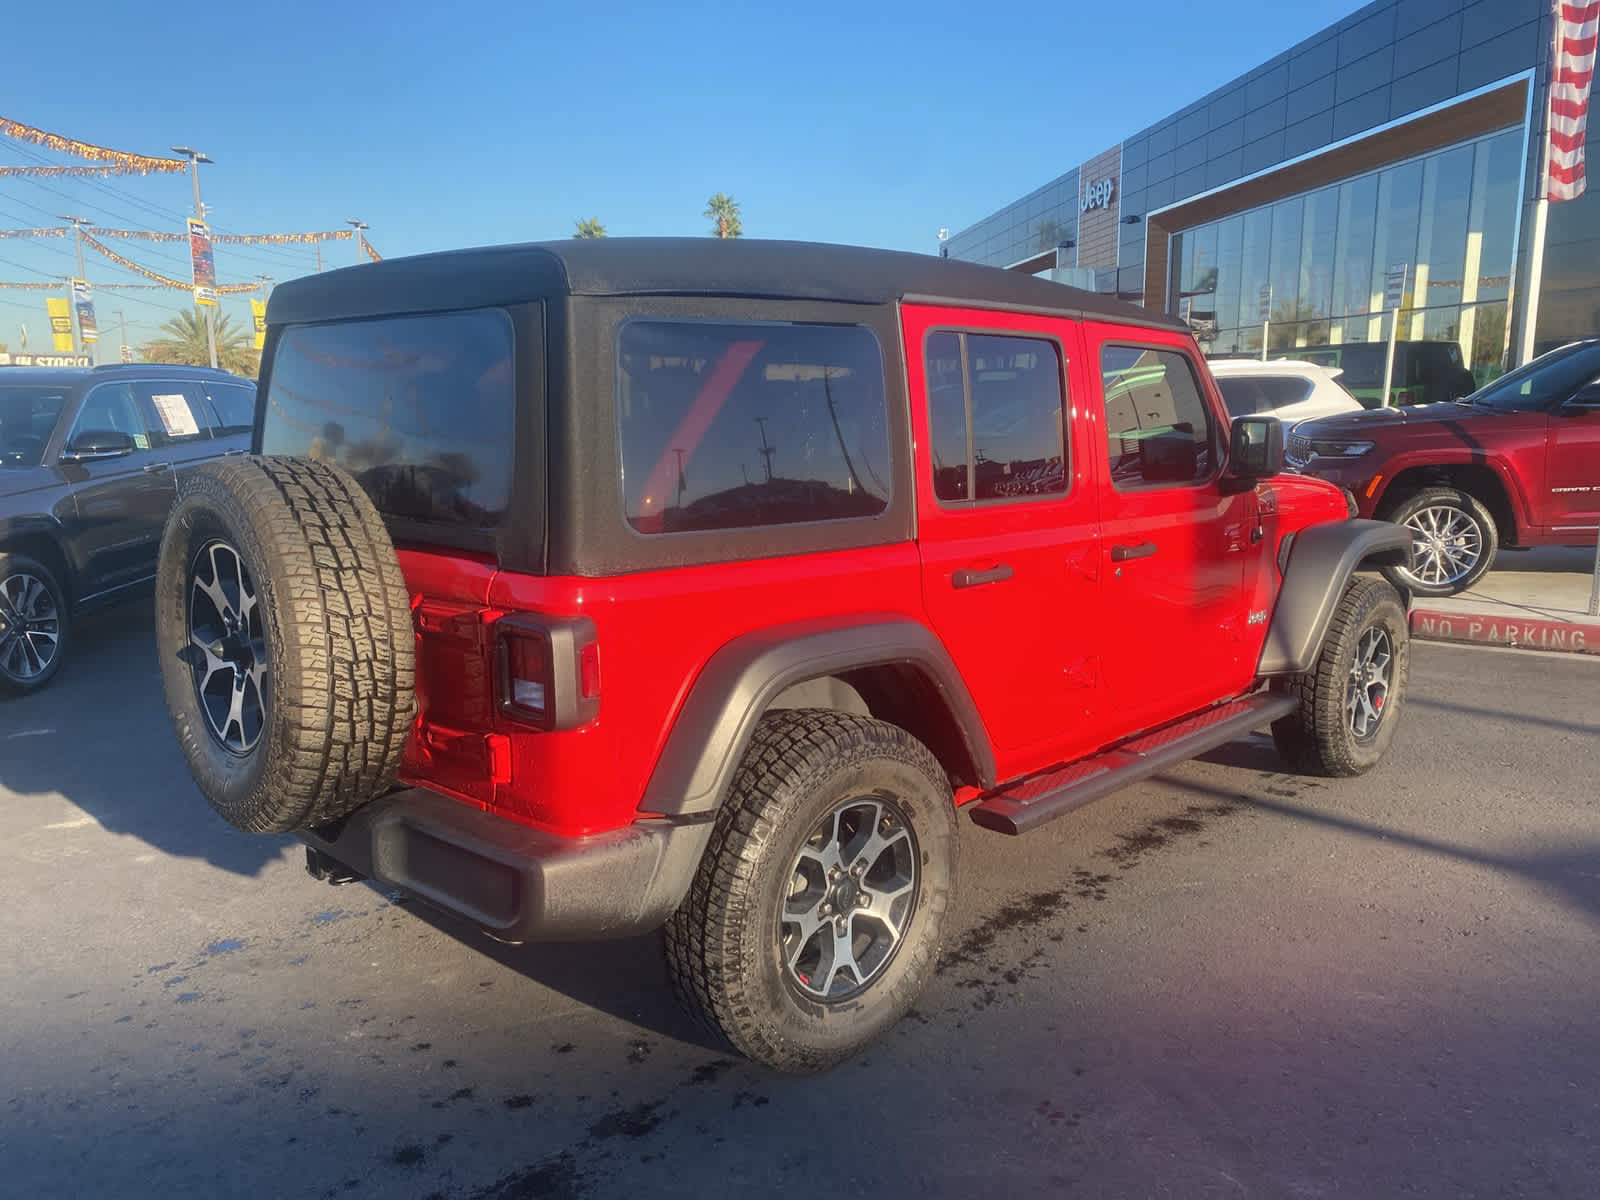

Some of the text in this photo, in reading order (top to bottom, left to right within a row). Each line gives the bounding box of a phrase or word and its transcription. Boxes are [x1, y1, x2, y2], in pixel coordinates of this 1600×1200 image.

[1081, 178, 1113, 211] Jeep
[1421, 617, 1586, 650] NO PARKING
